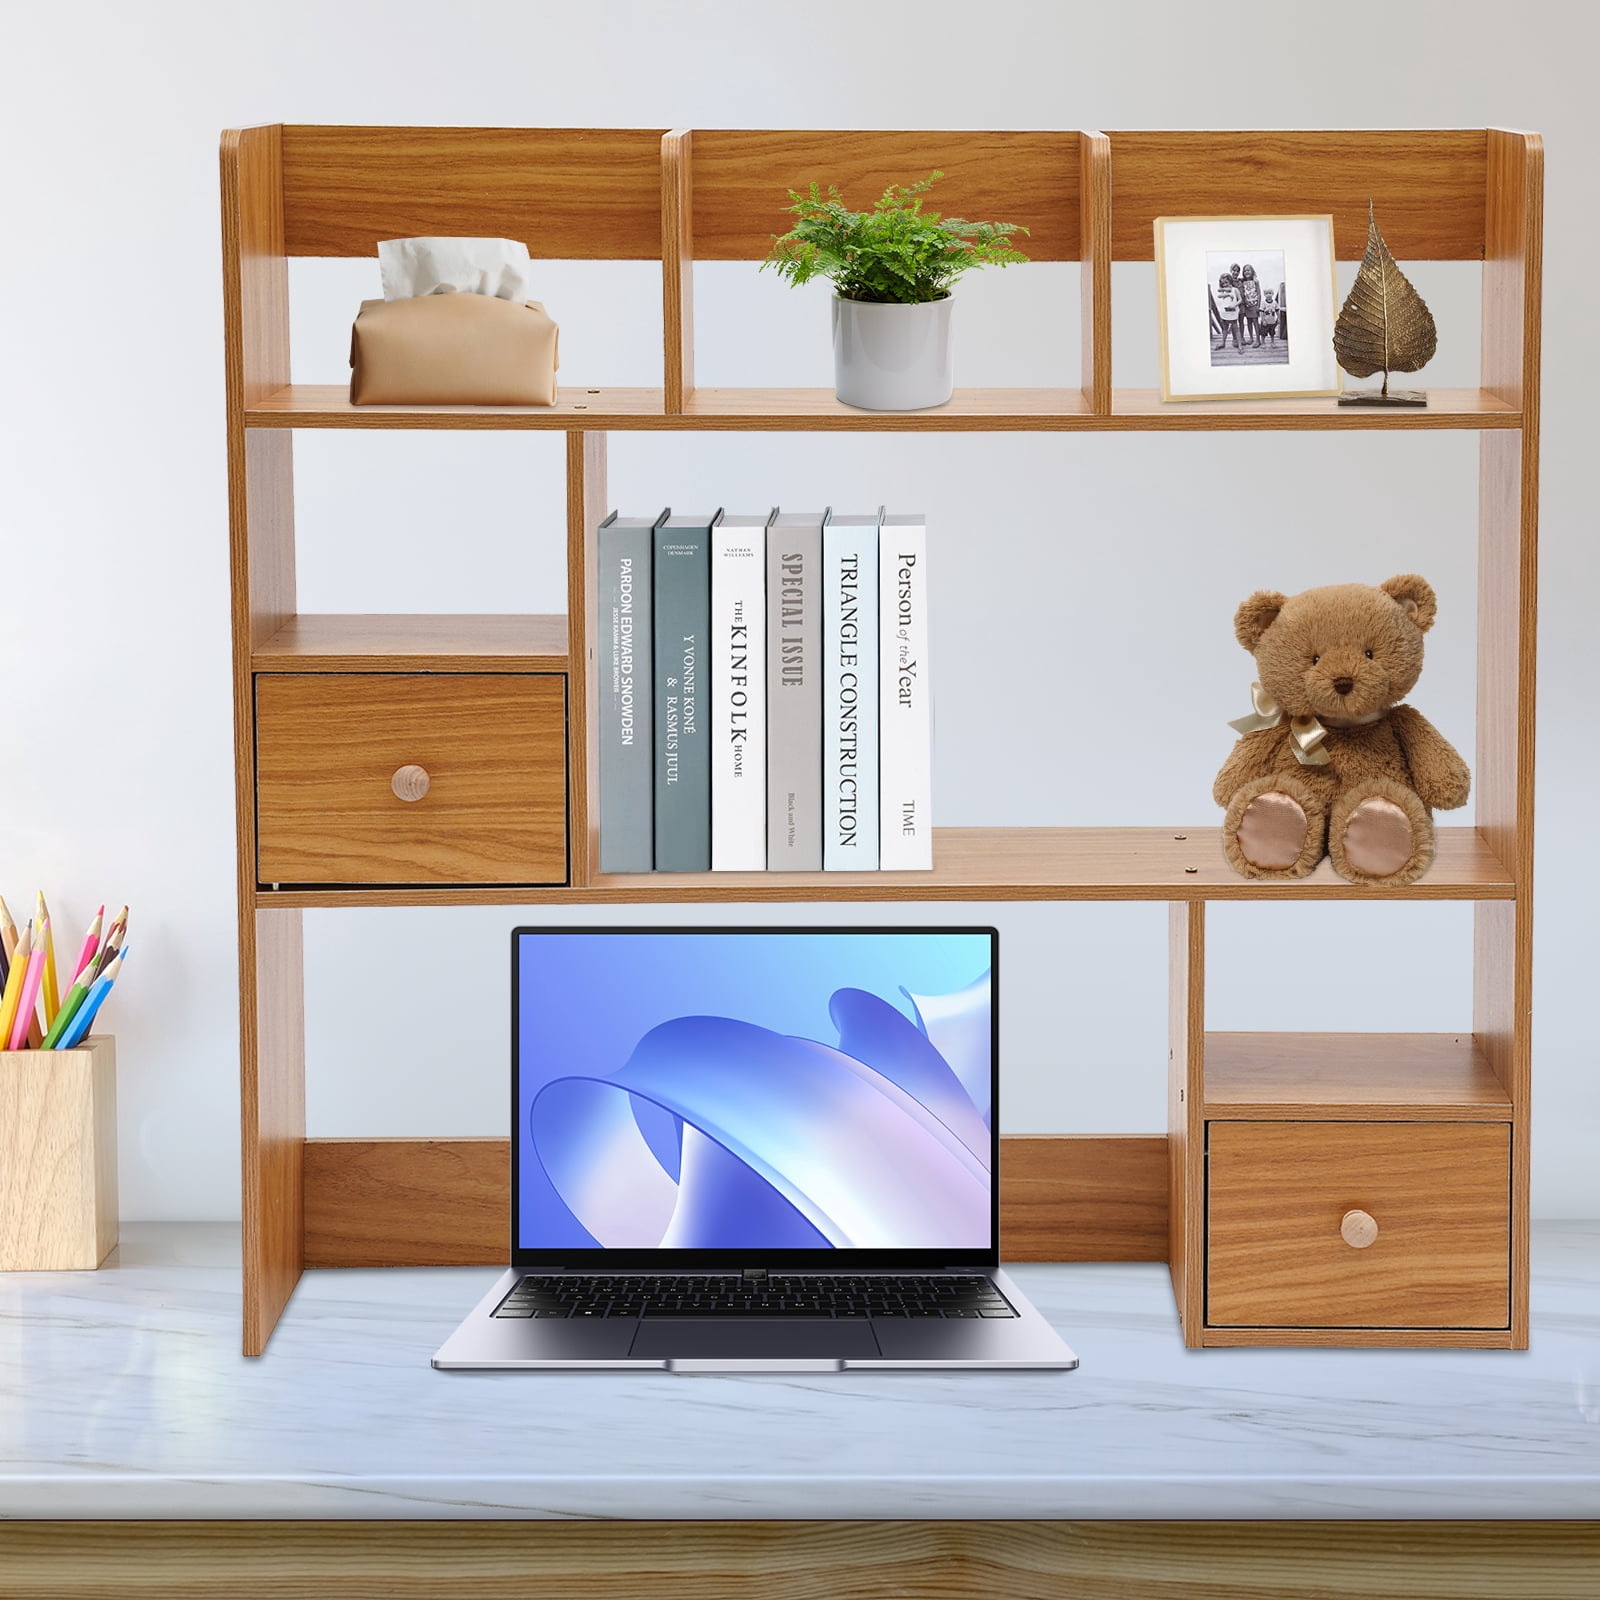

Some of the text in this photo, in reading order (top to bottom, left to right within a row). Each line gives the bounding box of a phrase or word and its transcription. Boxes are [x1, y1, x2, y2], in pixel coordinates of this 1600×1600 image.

[620, 558, 633, 745] PARDON EDWARD SNOWDEN
[781, 554, 804, 687] SPECIAL ISSUE
[895, 554, 916, 709] Person of the Year
[665, 676, 678, 785] & RASMUS JUUL
[683, 697, 696, 735] KONÉ
[731, 601, 747, 778] THE KINFOLK HOME
[838, 553, 858, 847] TRIANGLE CONSTRUCTION
[787, 793, 796, 847] Black and White
[902, 799, 916, 837] TIME
